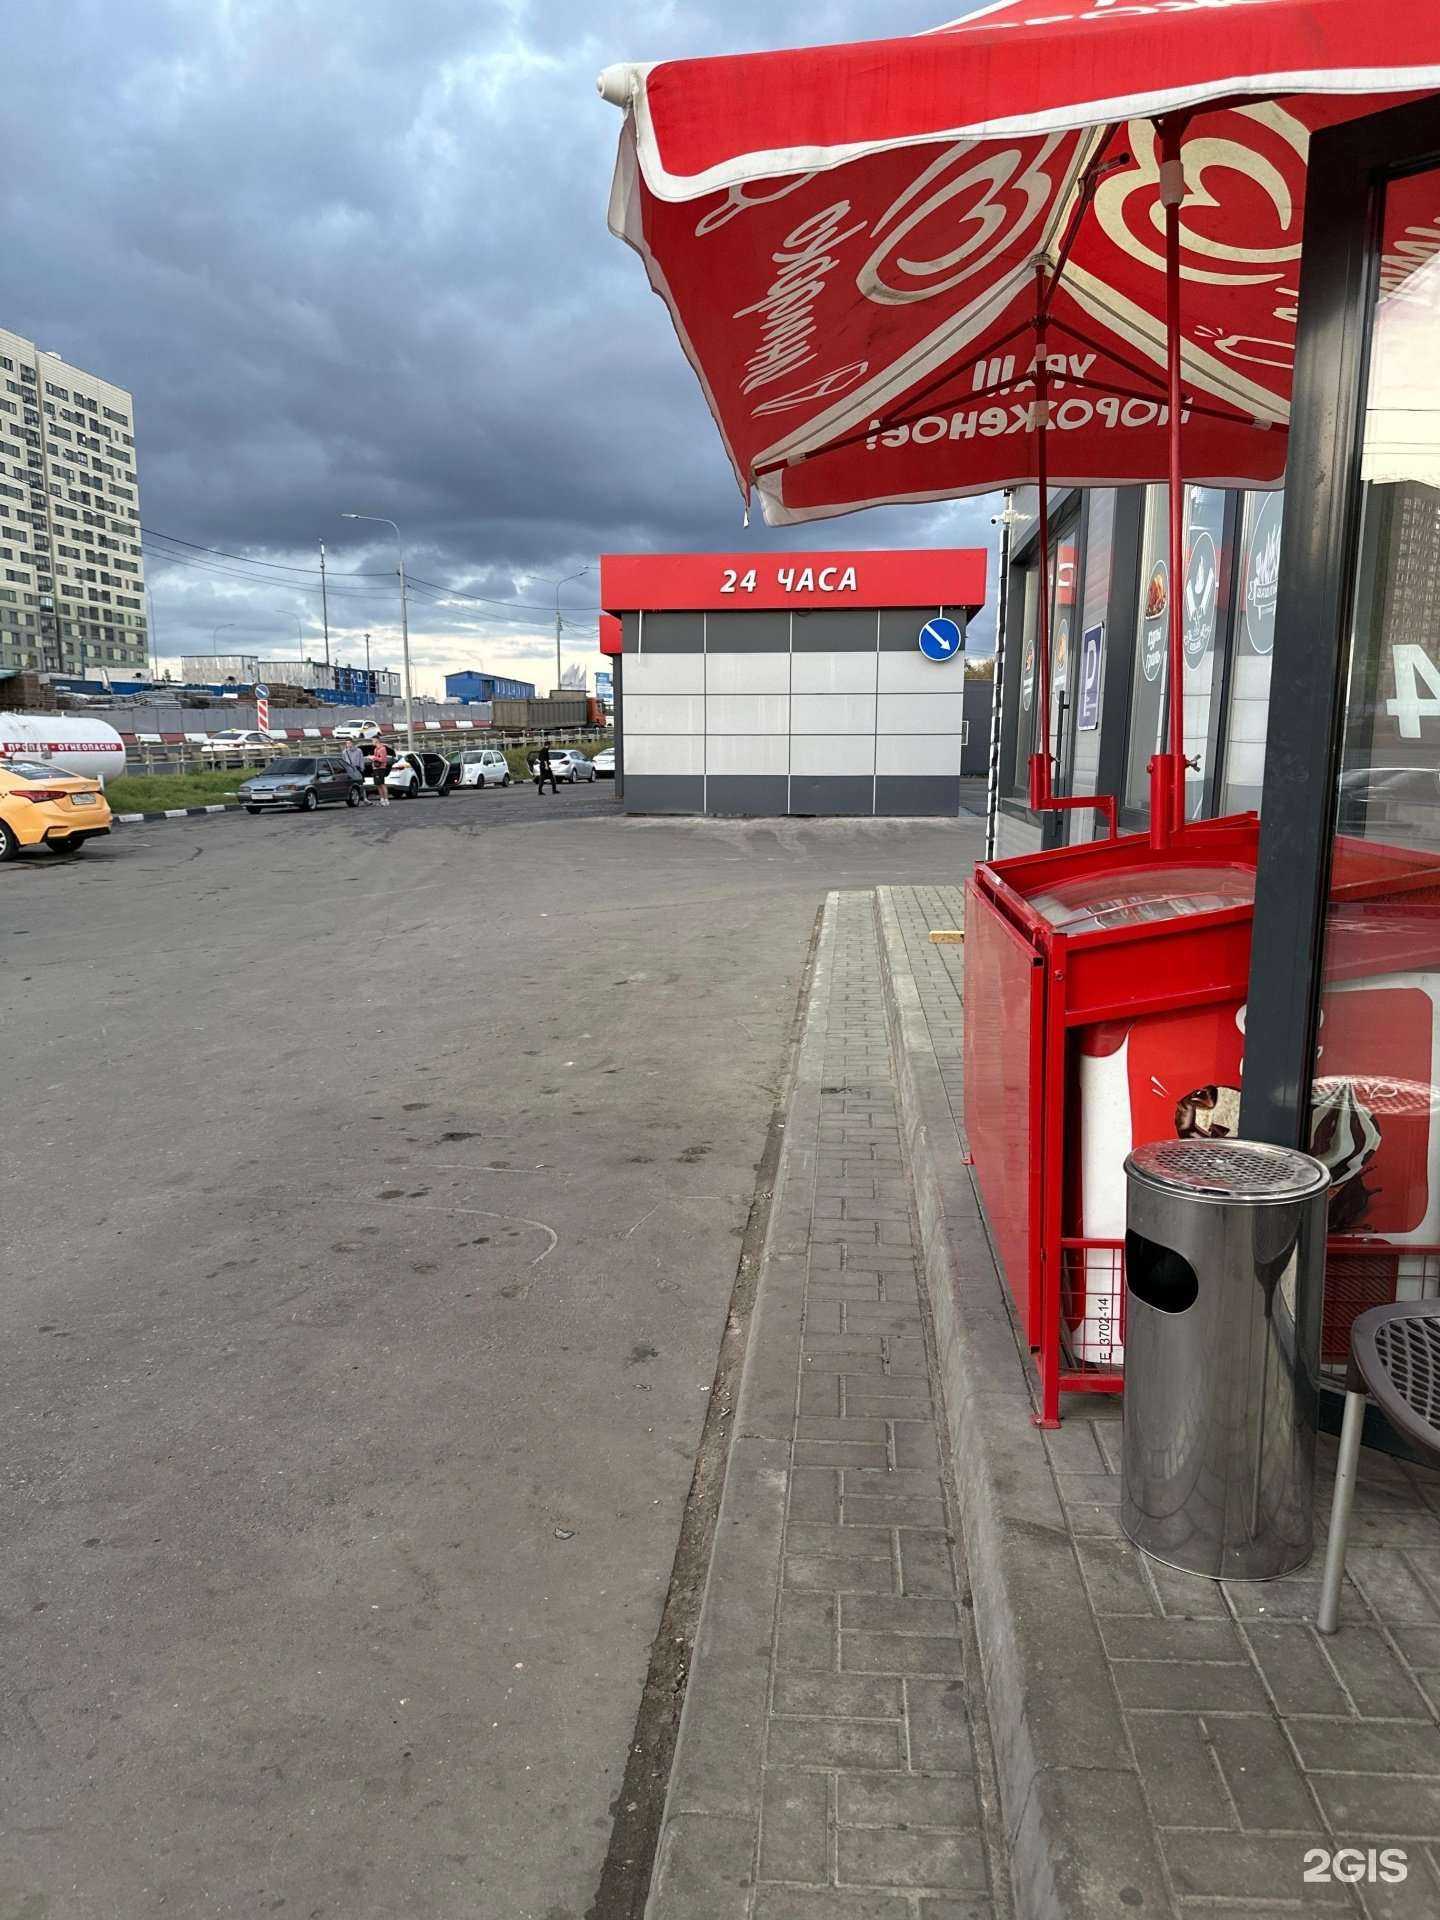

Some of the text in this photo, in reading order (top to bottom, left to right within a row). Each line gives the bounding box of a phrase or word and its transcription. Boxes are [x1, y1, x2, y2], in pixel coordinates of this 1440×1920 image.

[719, 567, 858, 593] 24 ЧАСА
[8, 743, 118, 752] ПРОПАН ОГНЕОПАСНО
[1097, 1298, 1110, 1345] 3702-14
